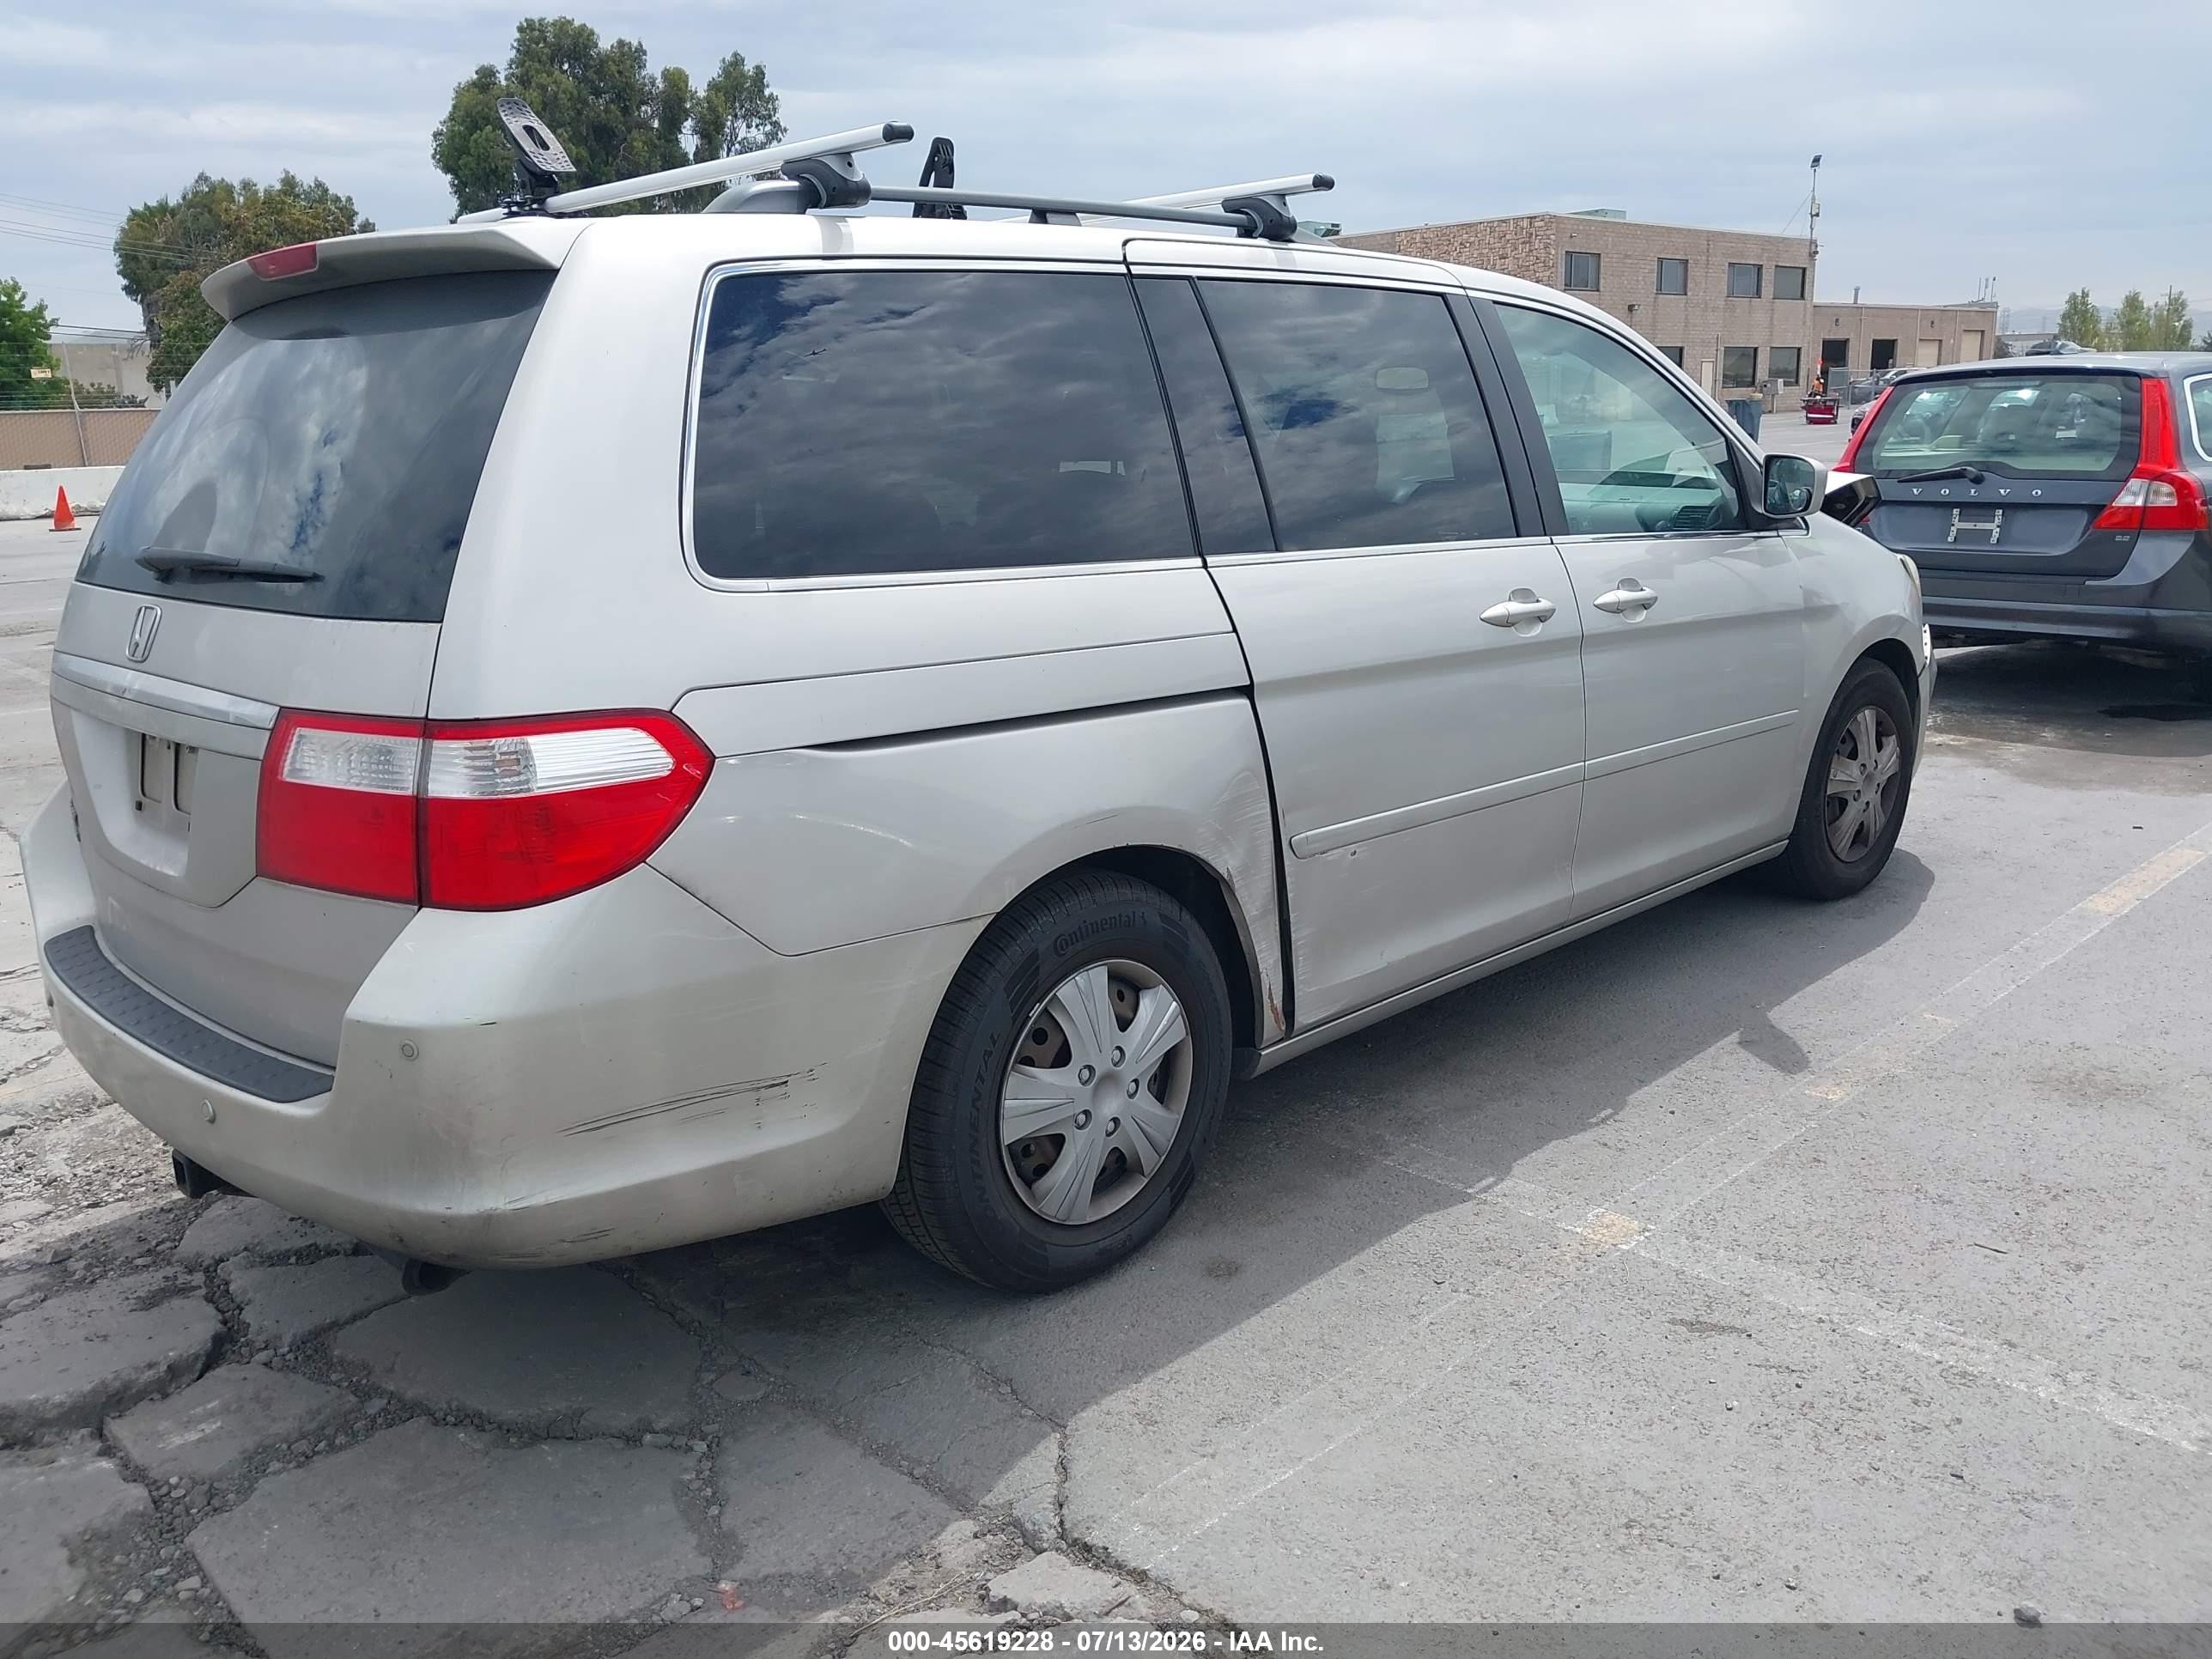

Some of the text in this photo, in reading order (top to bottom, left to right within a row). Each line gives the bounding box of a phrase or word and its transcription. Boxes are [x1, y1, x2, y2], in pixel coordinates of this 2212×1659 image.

[1911, 488, 2042, 497] VOLVO
[1054, 910, 1136, 956] Continental
[969, 1030, 1002, 1227] NTINENTAL
